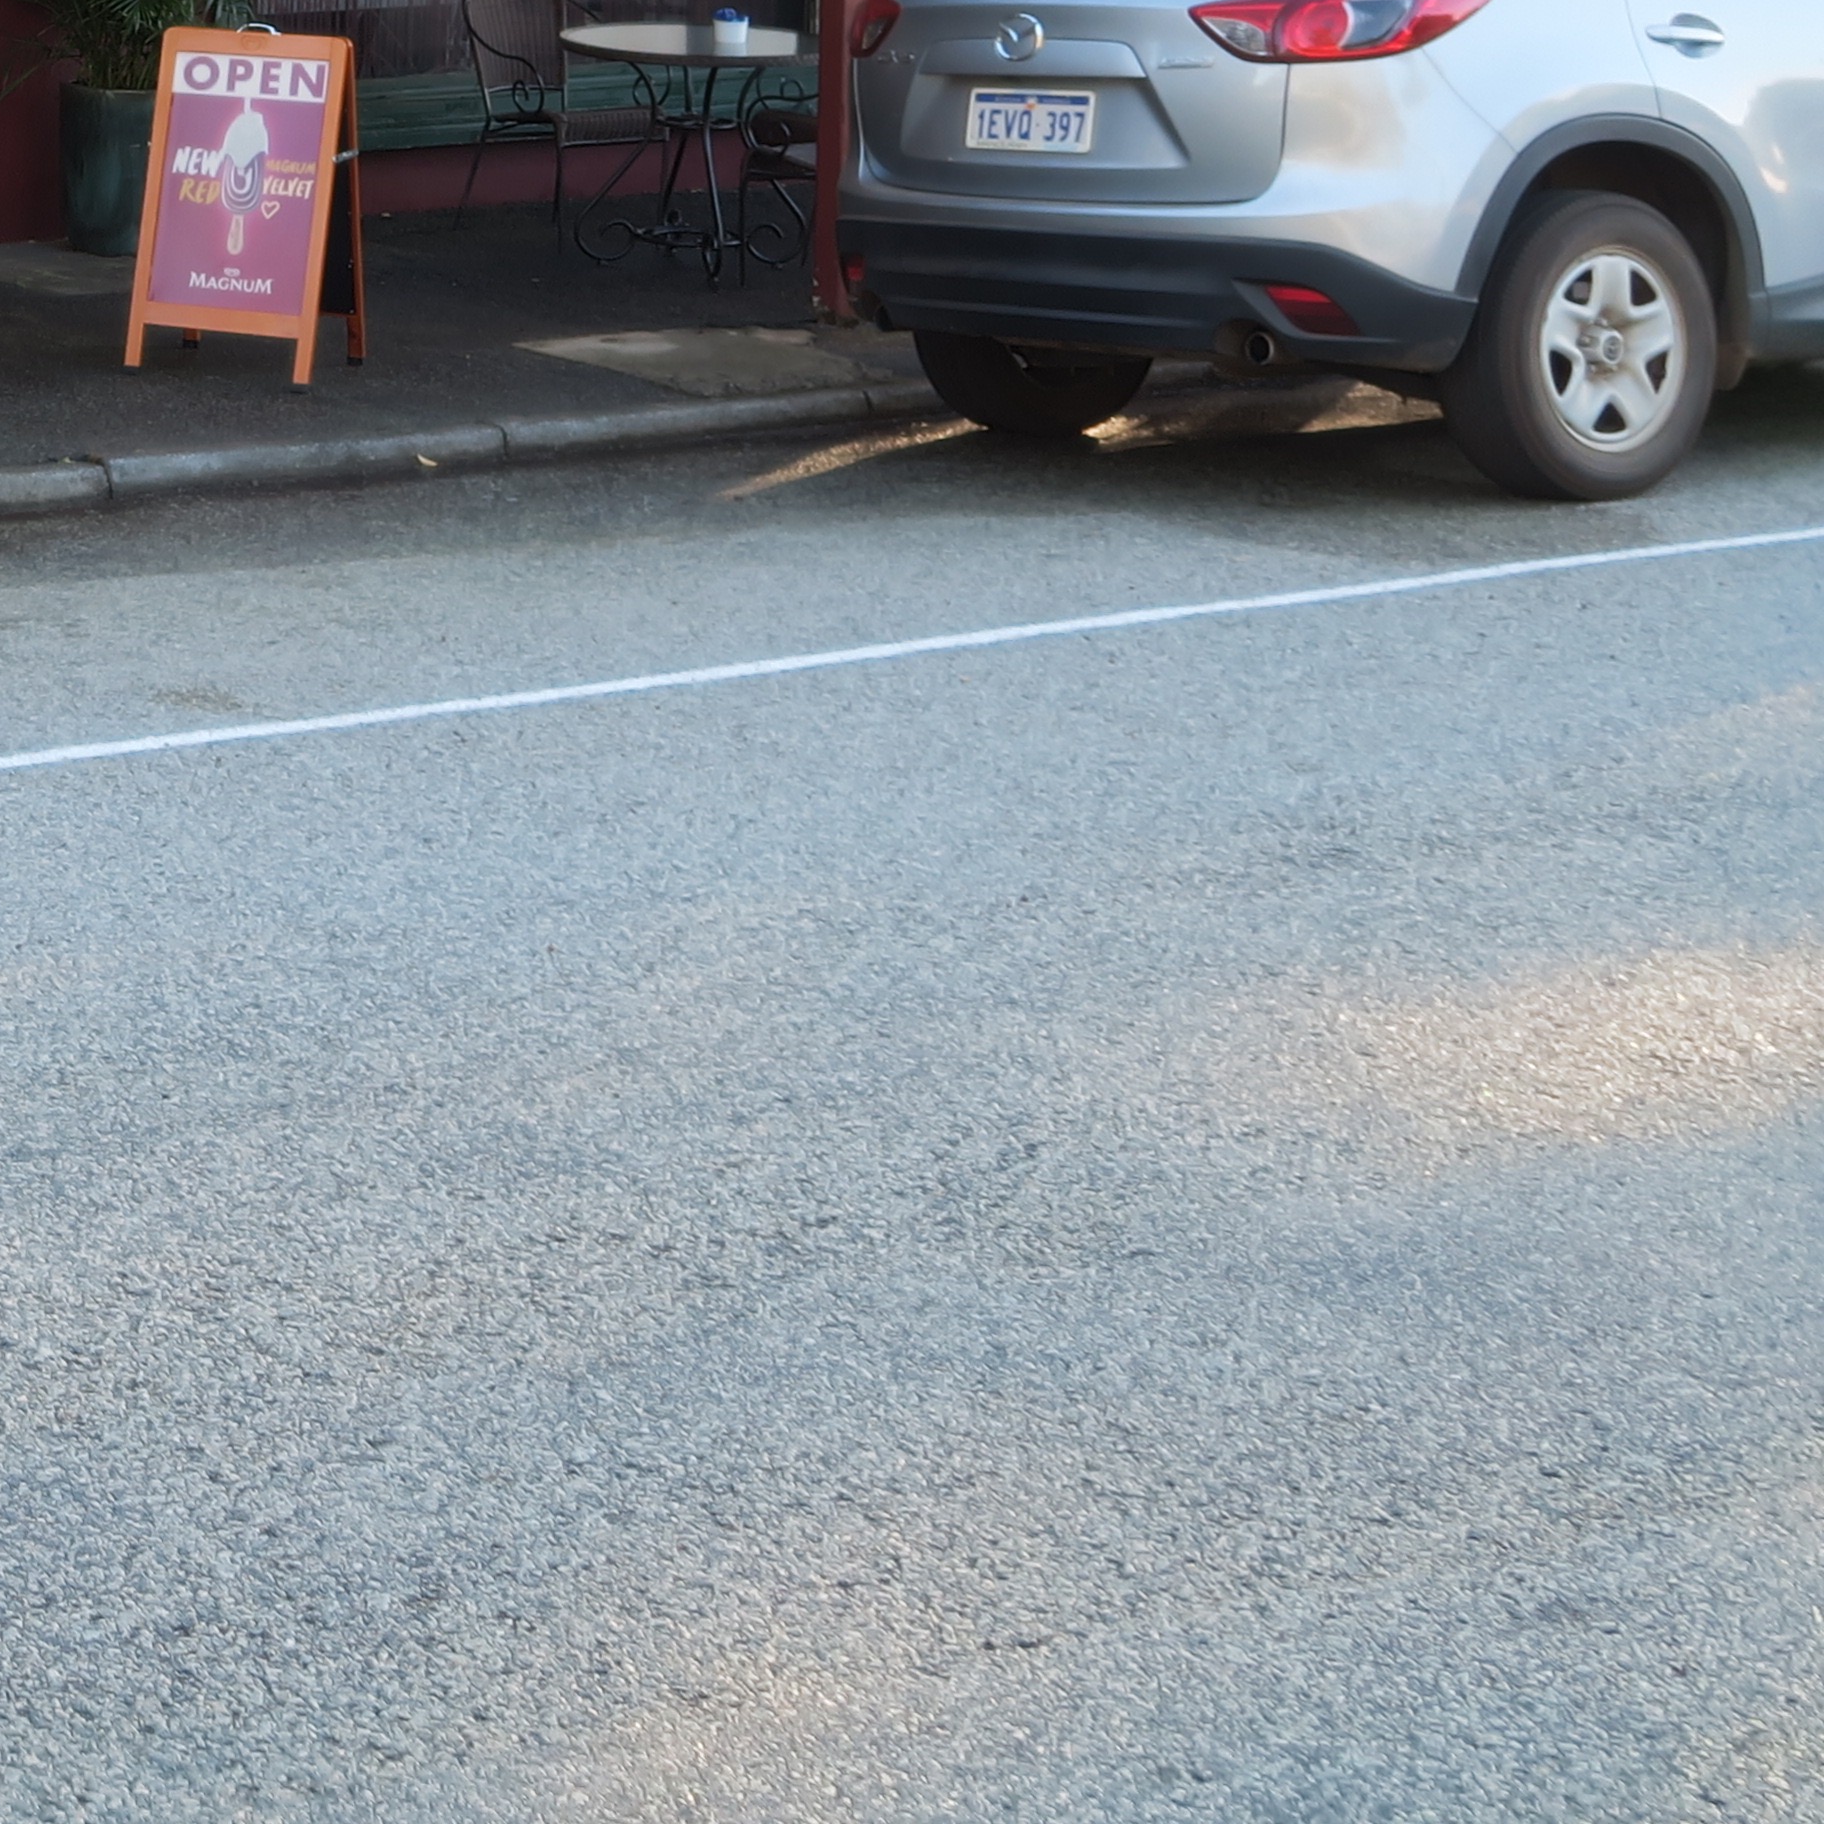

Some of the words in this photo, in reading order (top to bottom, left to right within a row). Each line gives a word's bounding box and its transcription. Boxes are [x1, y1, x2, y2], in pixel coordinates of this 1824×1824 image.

[183, 55, 327, 99] OPEN
[1043, 111, 1086, 143] 397
[172, 146, 227, 178] NEW
[179, 178, 221, 204] RED
[262, 175, 315, 200] VELVET
[188, 271, 274, 295] MAGNUM
